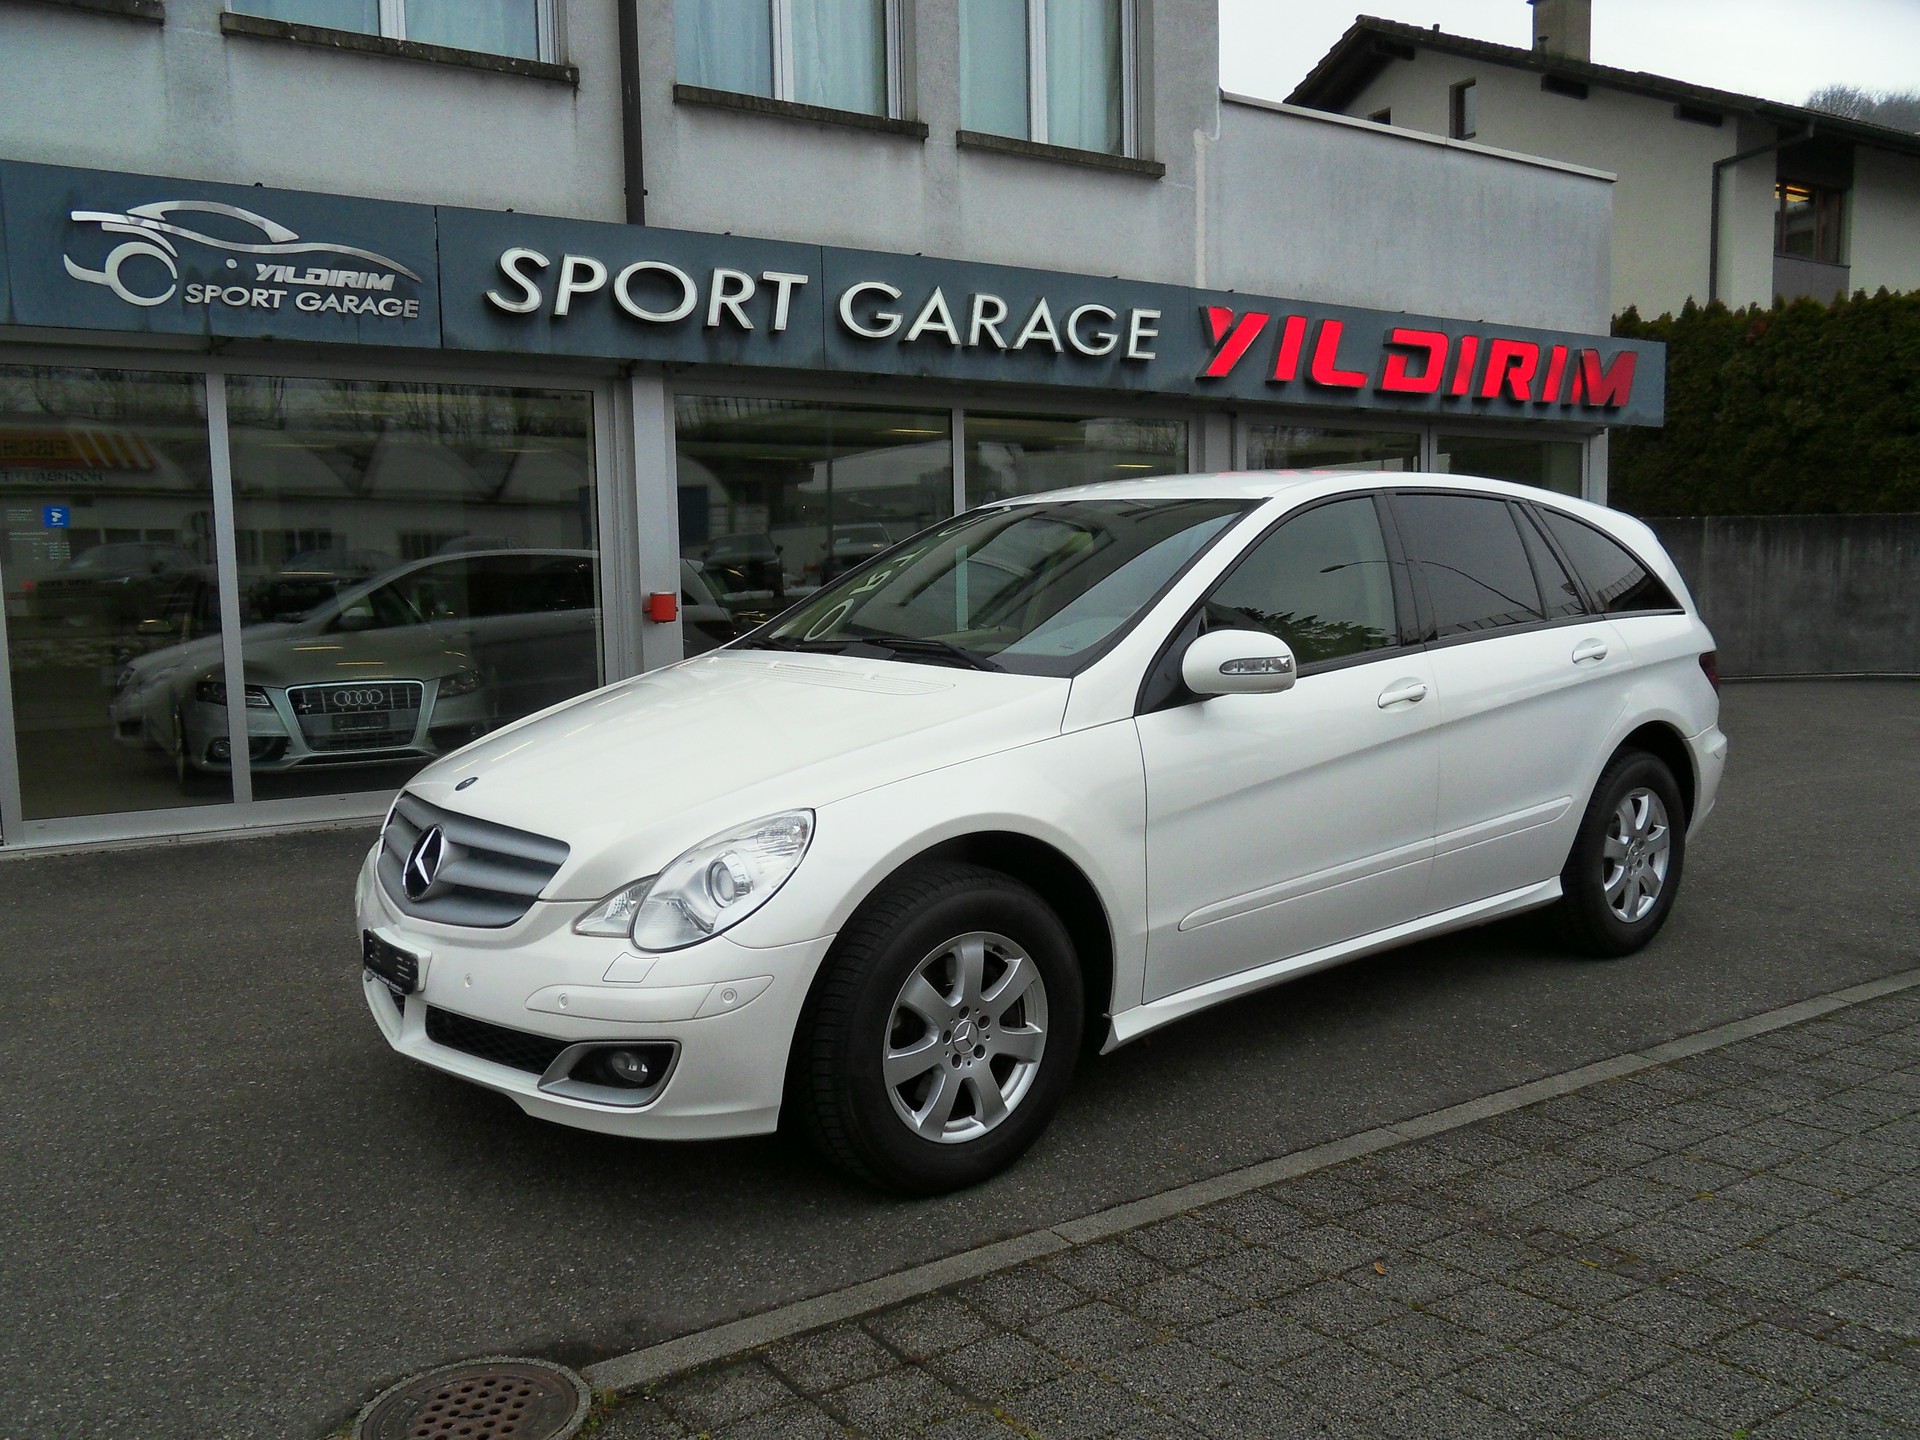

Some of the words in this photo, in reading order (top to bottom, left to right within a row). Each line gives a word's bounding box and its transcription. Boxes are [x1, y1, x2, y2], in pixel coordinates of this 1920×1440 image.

[255, 264, 396, 291] YILDIRIM
[184, 285, 288, 309] SPORT
[295, 291, 420, 318] GARAGE
[485, 247, 809, 332] SPORT
[838, 280, 1162, 361] GARAGE
[1197, 306, 1638, 408] YILDIRIM
